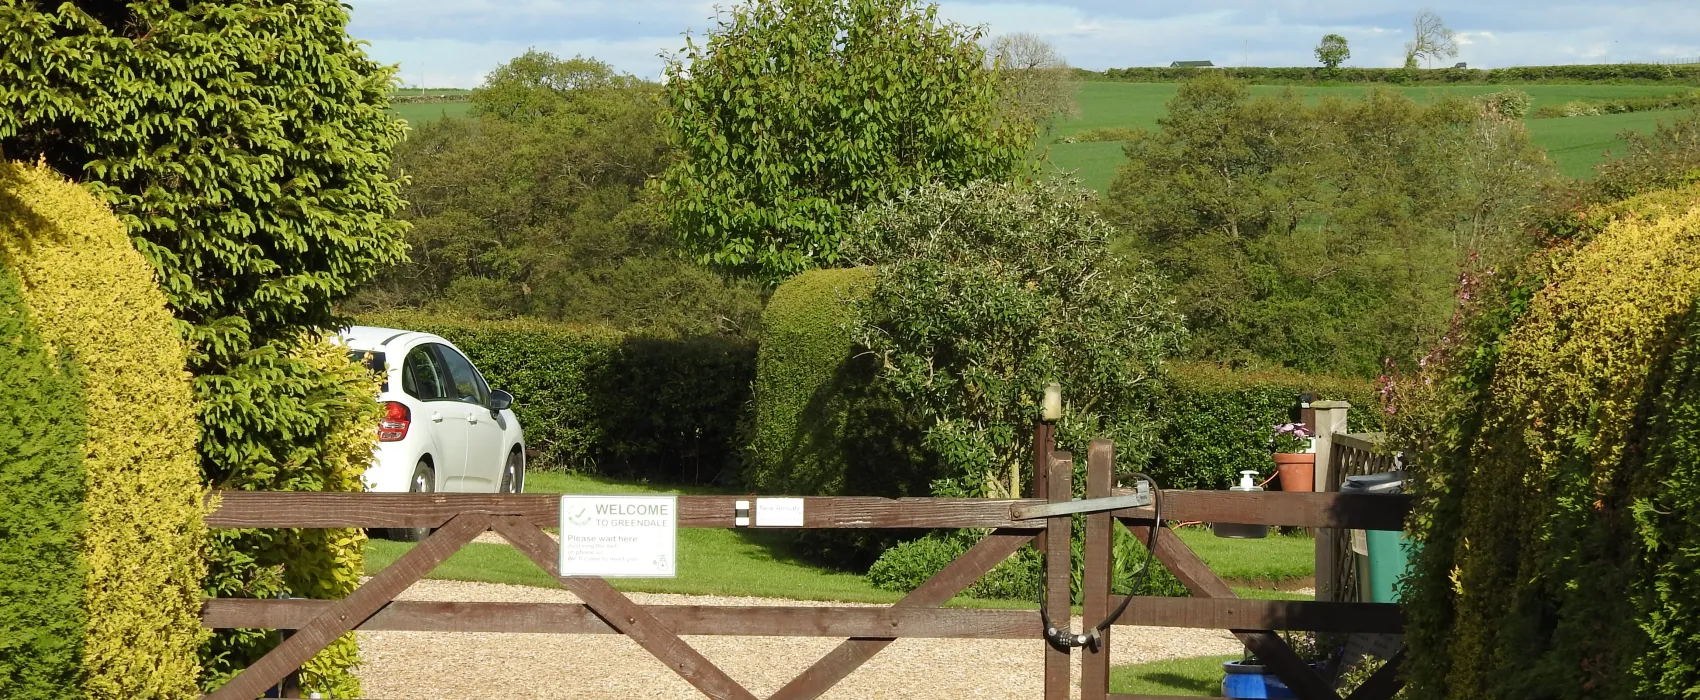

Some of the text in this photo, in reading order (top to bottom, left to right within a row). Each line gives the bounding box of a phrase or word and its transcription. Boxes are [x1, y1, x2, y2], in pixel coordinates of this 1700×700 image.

[595, 504, 668, 515] WELCOME
[596, 519, 609, 527] TO
[611, 519, 667, 527] GREENDALE
[567, 534, 638, 542] Please wait here
